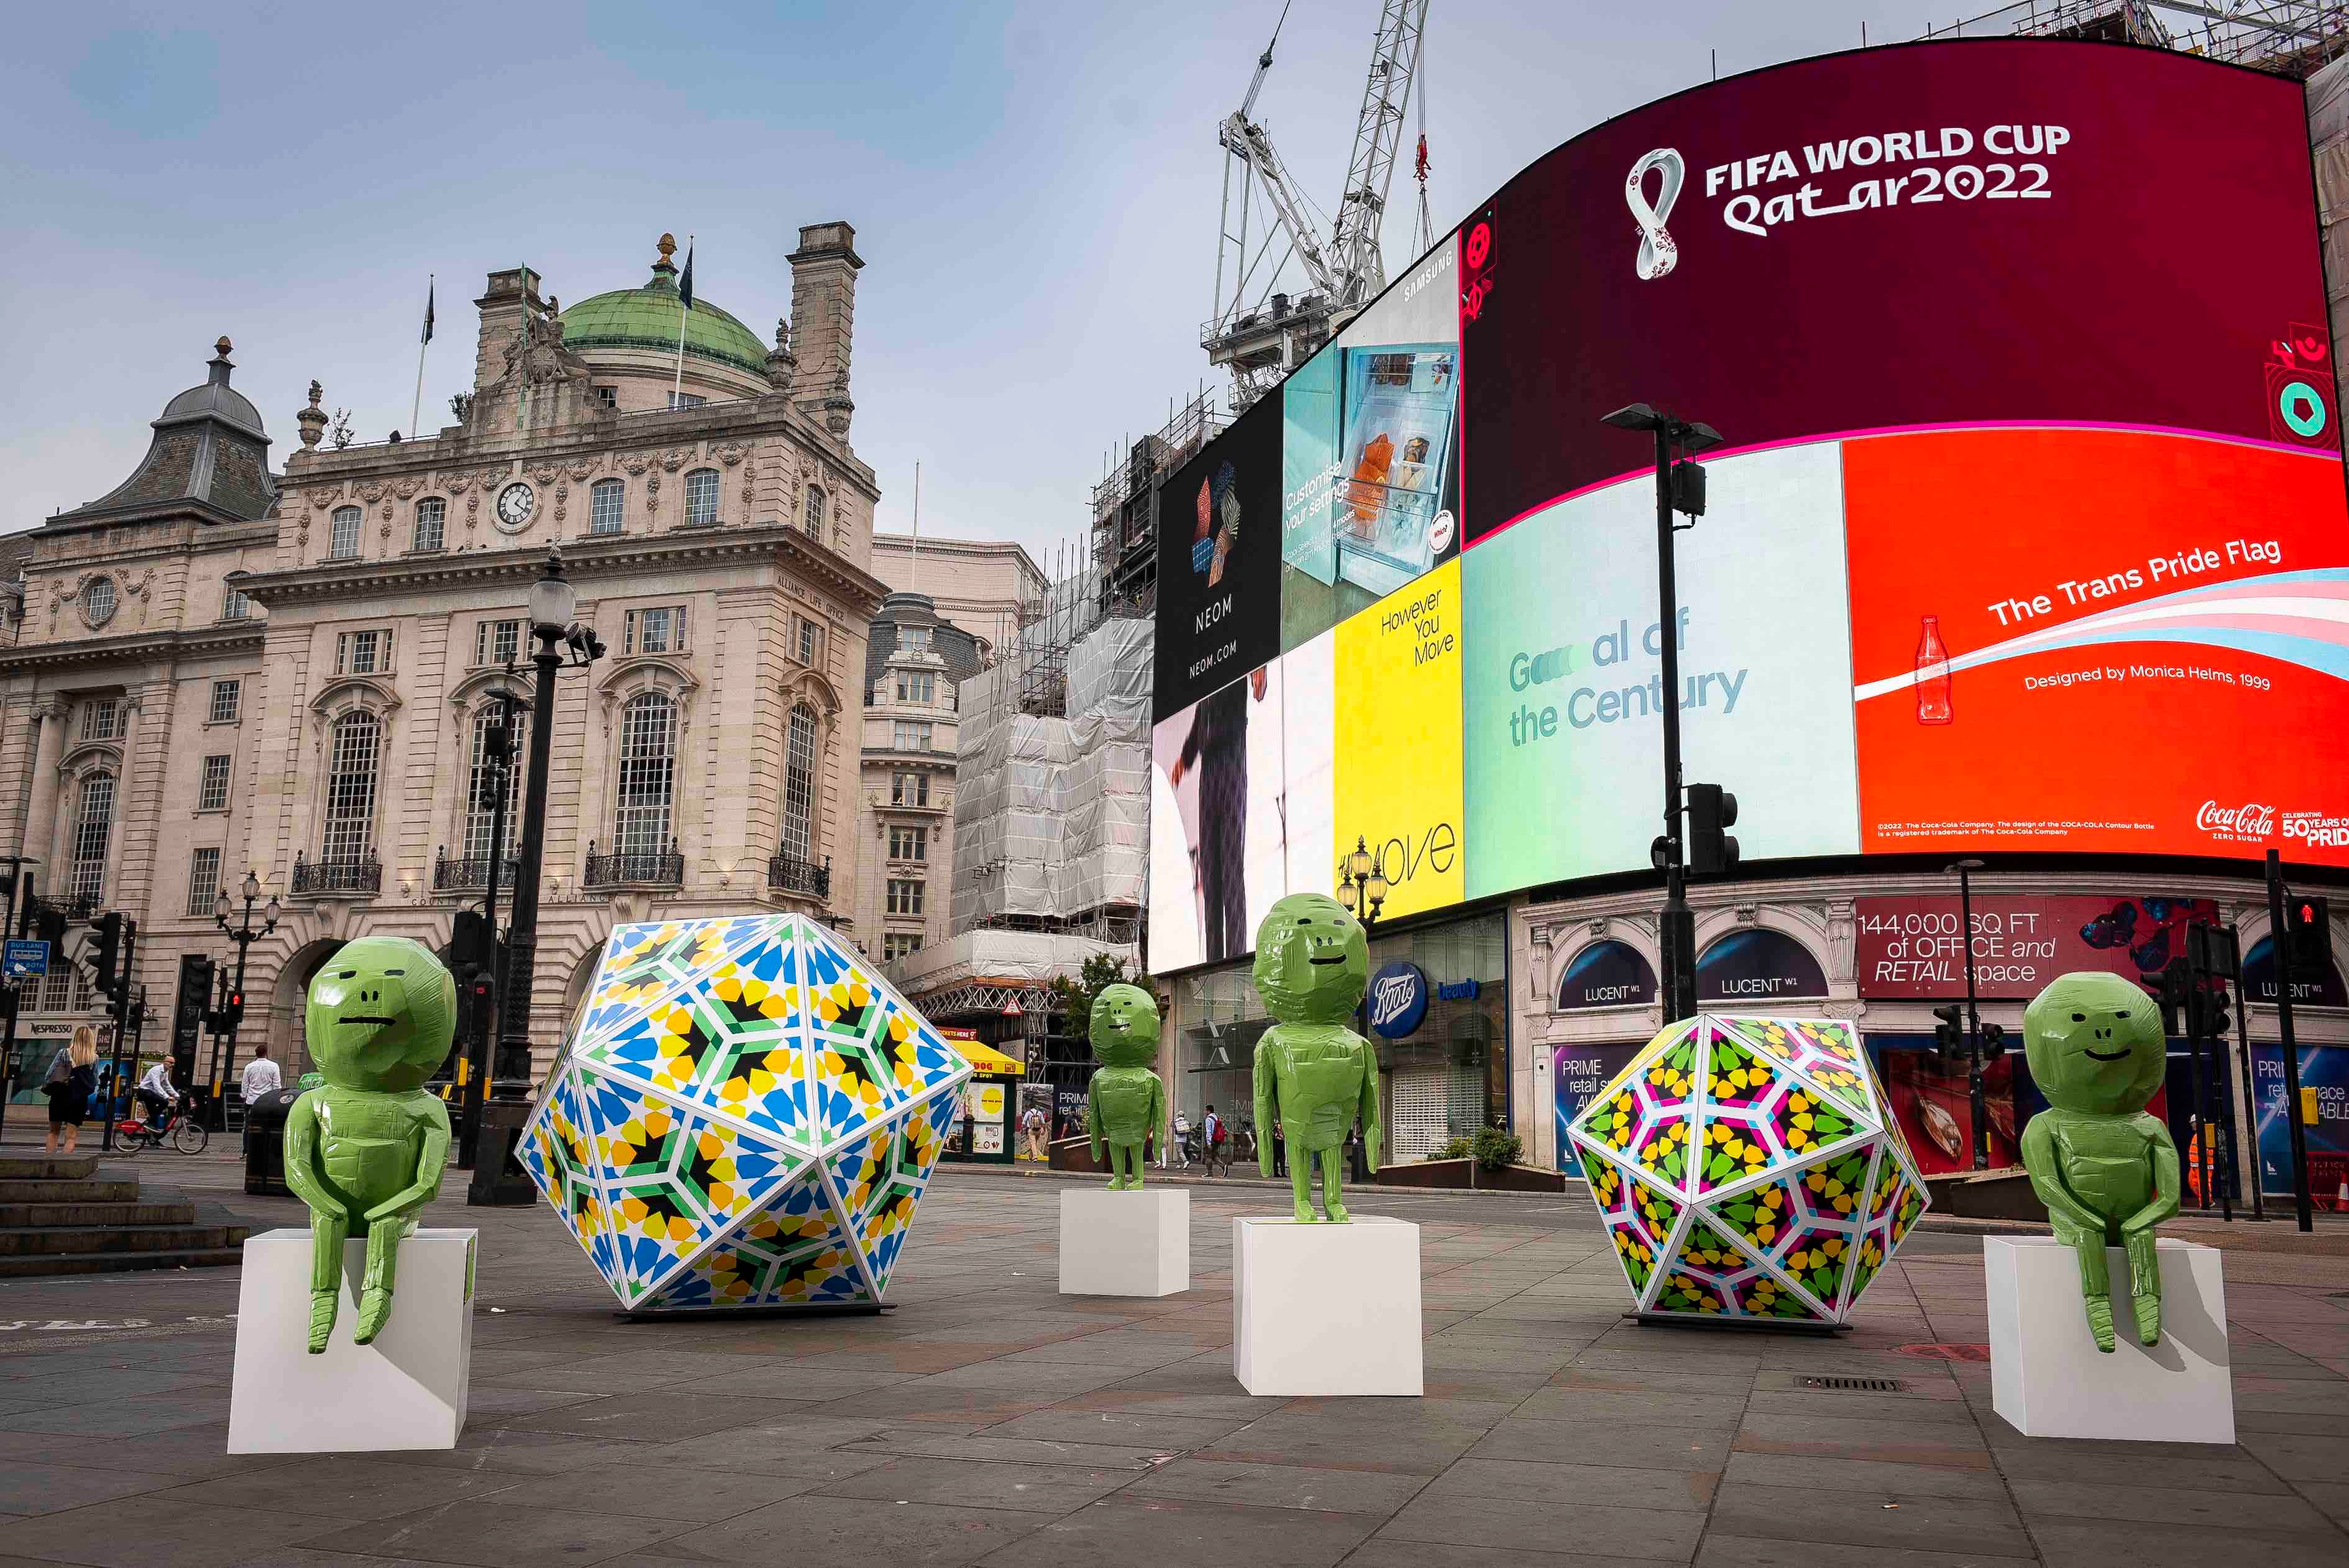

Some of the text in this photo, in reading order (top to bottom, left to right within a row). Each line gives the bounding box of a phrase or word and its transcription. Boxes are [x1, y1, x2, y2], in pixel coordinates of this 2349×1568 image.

[1706, 125, 2071, 198] FIFA WORLD CUP
[1403, 250, 1453, 303] SAMSUNG
[1286, 460, 1342, 511] Customise
[1286, 477, 1350, 539] your settings
[1988, 538, 2283, 626] The Trans Pride Flag
[1195, 594, 1232, 634] NEOM
[1381, 589, 1442, 636] However
[1415, 619, 1439, 641] You
[1189, 639, 1237, 679] NEOM.COM
[1414, 635, 1454, 667] Move
[2025, 665, 2271, 691] Designed by Monica Helms, 1999
[1509, 669, 1748, 746] the Century
[1960, 821, 1995, 830] Company.
[2196, 800, 2277, 835] Coca-Cola
[2283, 818, 2310, 838] 50
[2309, 818, 2340, 828] YEARS
[2237, 835, 2263, 843] SUGAR
[2307, 828, 2349, 847] PRID
[1858, 913, 2040, 938] 144,000 SQ FT
[1887, 937, 2056, 958] of OFFCE and
[1875, 961, 1957, 982] RETAIL
[1439, 978, 1481, 1001] beauty
[1585, 986, 1628, 1001] LUCENT
[1722, 978, 1782, 994] LUCENT
[2262, 982, 2310, 998] LUENT
[1372, 973, 1416, 1025] Boots
[30, 1023, 72, 1034] NESPRESSO
[1563, 1059, 1602, 1076] PRIME
[2258, 1061, 2304, 1079] PRIE
[1570, 1077, 1596, 1093] retail
